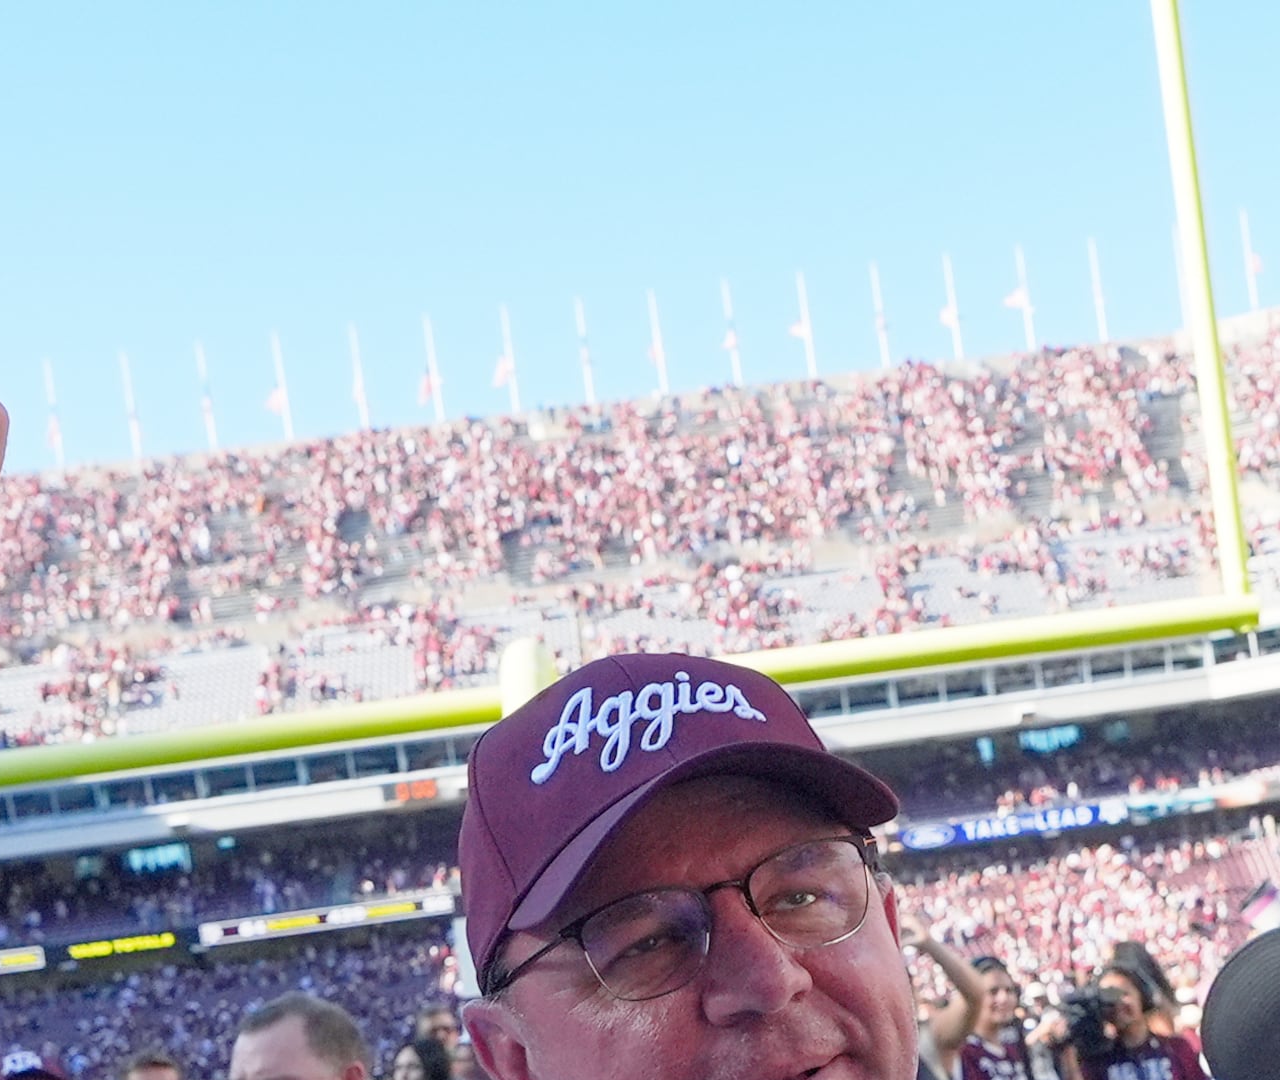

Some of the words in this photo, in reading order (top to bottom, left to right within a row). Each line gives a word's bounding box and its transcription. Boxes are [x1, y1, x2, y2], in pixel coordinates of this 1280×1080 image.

[531, 671, 767, 784] Aggies
[962, 814, 1020, 841] TAKE
[1034, 806, 1093, 831] LEAD
